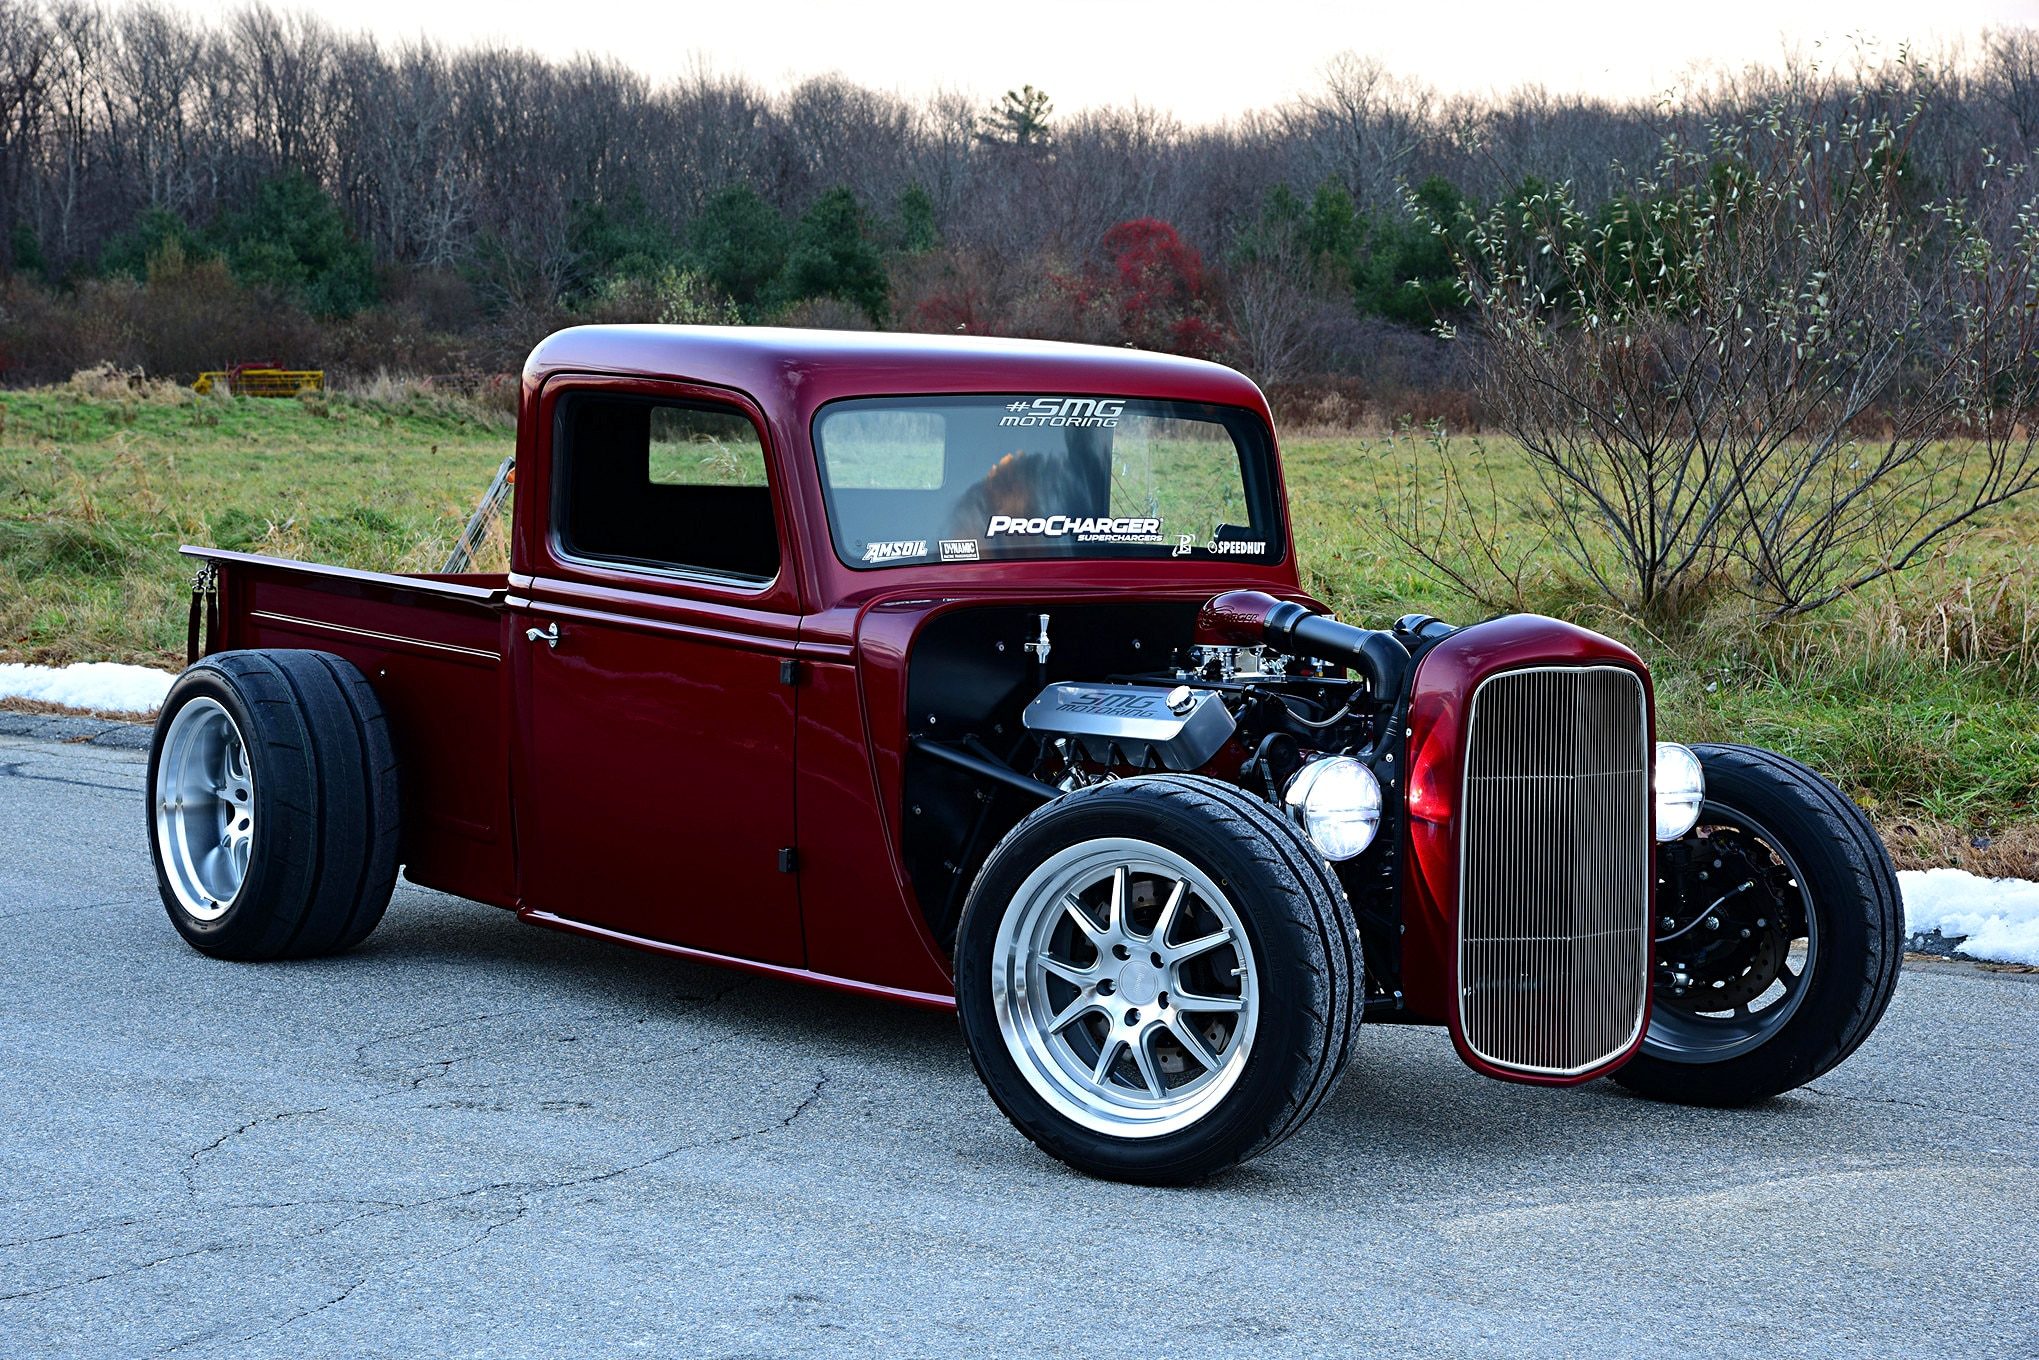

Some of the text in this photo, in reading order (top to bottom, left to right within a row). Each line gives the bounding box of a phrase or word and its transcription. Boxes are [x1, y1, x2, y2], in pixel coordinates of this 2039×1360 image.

[1005, 398, 1126, 417] #SMG
[999, 416, 1119, 428] MOTORING
[1077, 534, 1163, 542] SUPERCHARGERS
[862, 540, 928, 563] AMSOIL
[944, 542, 975, 555] DYNAMIC
[1218, 541, 1266, 555] SPEEDHUT
[1071, 692, 1163, 709] SMG
[1056, 703, 1159, 717] MOTORING
